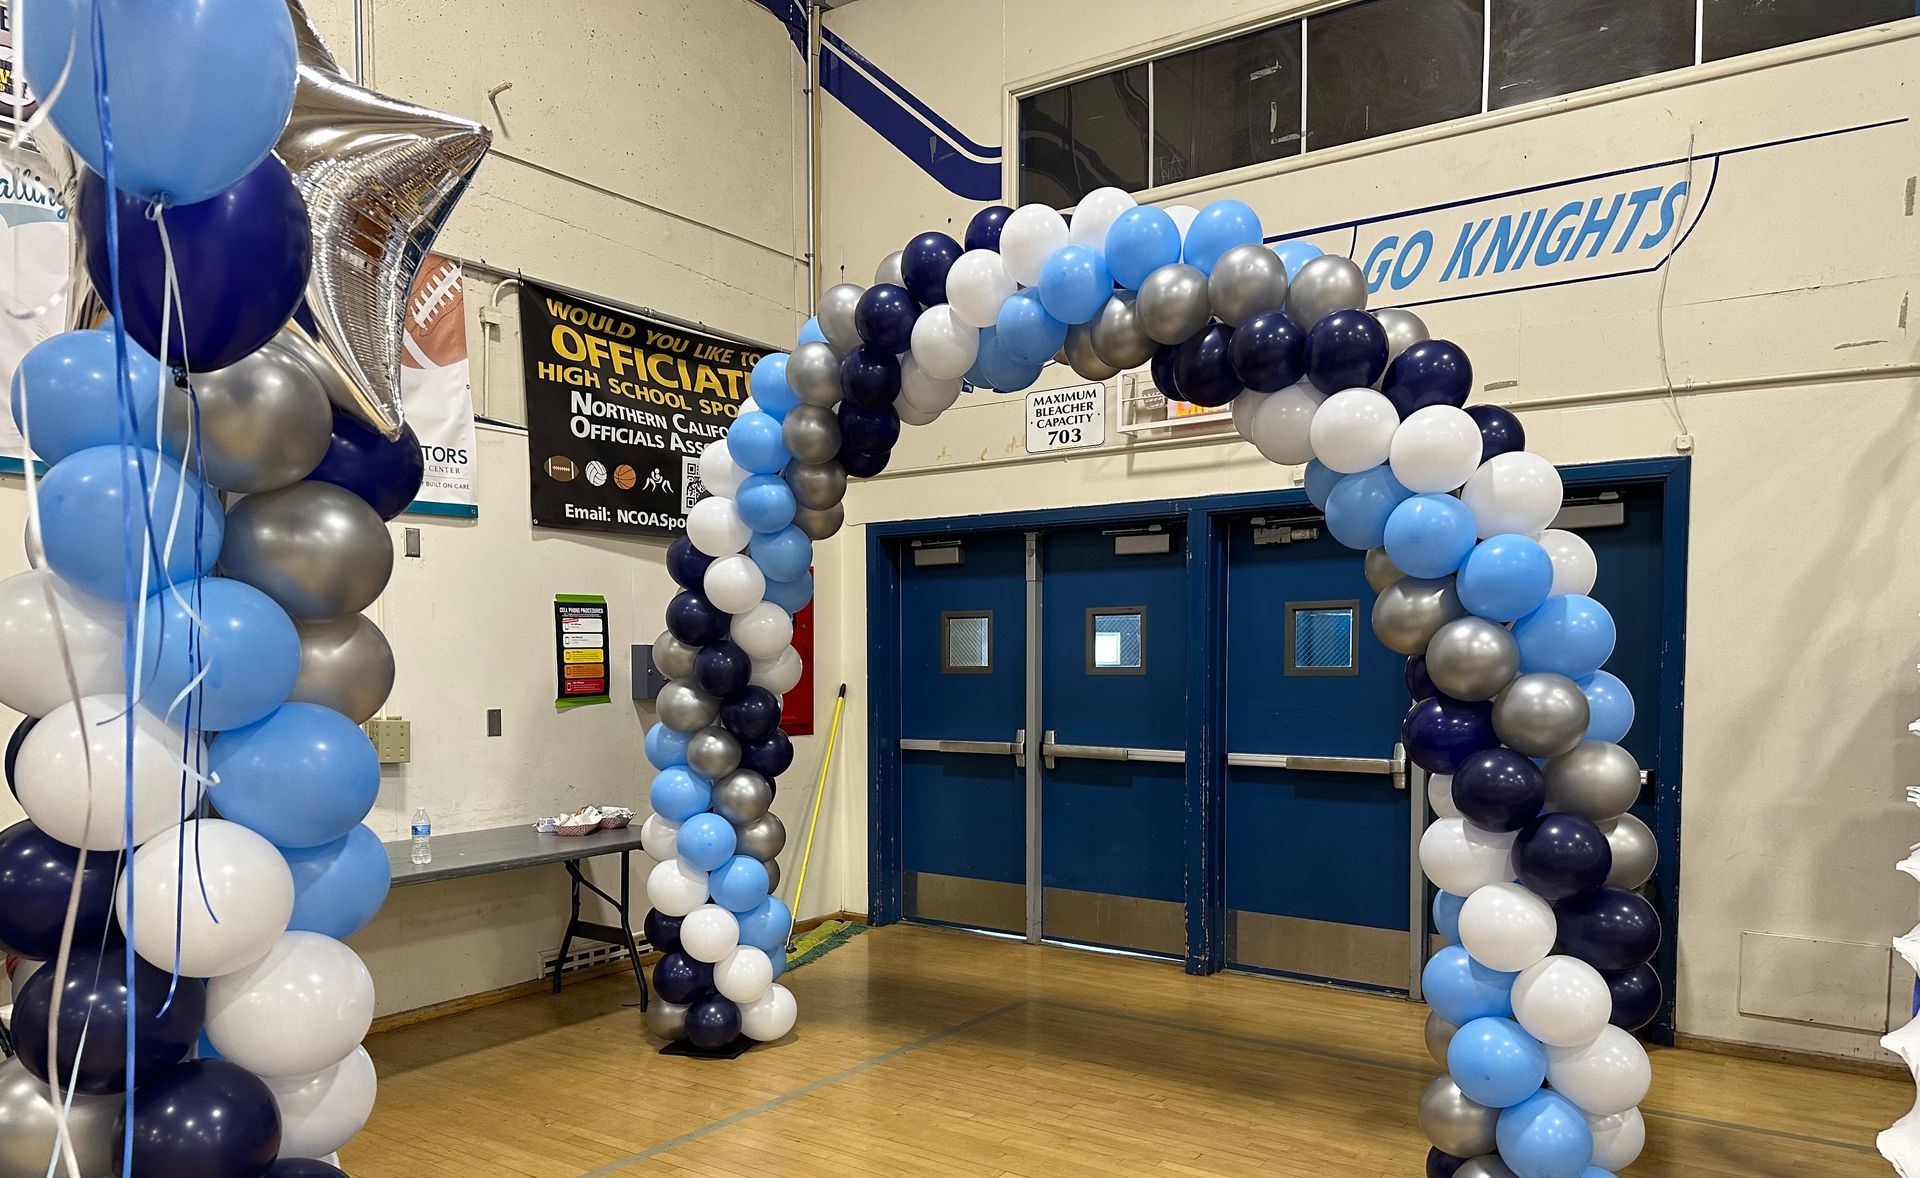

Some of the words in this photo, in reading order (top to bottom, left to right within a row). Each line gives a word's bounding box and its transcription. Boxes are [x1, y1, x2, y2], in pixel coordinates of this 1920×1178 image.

[1362, 229, 1434, 295] GO
[1438, 181, 1688, 283] KNIGHTS
[546, 298, 636, 339] WOULD
[647, 329, 690, 352] YOU
[694, 344, 738, 364] LIKE
[538, 361, 601, 389] HIGH
[610, 379, 691, 411] SCHOOL
[700, 399, 740, 419] SPO
[1033, 388, 1097, 407] MAXIMUM
[571, 391, 667, 430] NORTHERN
[1035, 401, 1094, 418] BLEACHER
[1036, 413, 1094, 429] CAPACITY
[570, 416, 665, 449] OFFICIALS
[670, 433, 708, 456] ASS
[1048, 428, 1082, 446] 703
[420, 445, 468, 465] TORS
[428, 465, 461, 474] CENTER
[565, 503, 611, 523] Email:
